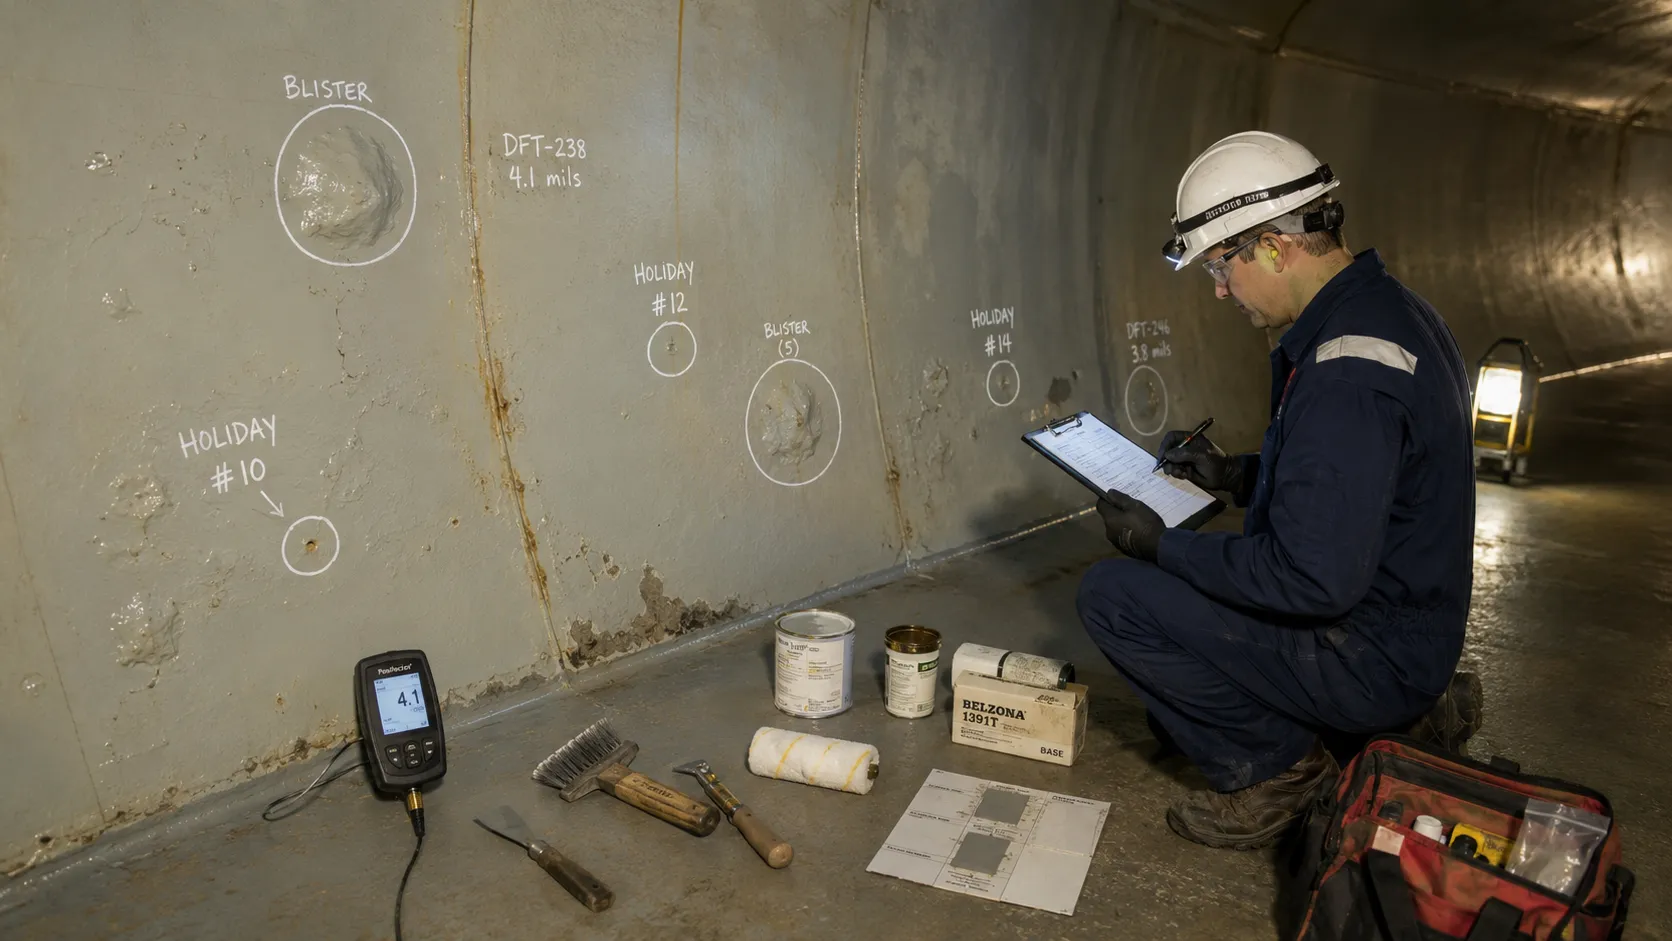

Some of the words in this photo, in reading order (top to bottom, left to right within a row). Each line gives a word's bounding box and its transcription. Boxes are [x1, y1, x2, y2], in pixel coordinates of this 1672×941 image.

[283, 75, 373, 103] BLISTER
[503, 133, 587, 160] DFT-238
[509, 165, 535, 189] 4.1
[546, 166, 582, 188] mils
[651, 291, 688, 317] #12
[970, 306, 1014, 329] HOLIDAY
[763, 320, 811, 339] BLISTER
[1126, 319, 1171, 340] DFT-246
[778, 338, 800, 358] (5)
[984, 333, 1012, 357] #14
[1131, 343, 1149, 363] 3.8
[1151, 340, 1172, 358] mils
[178, 414, 276, 460] HOLIDAY
[210, 457, 267, 495] #10
[397, 689, 420, 707] 4.1
[962, 699, 1026, 721] BELZONA
[962, 711, 999, 728] 1391T
[1040, 746, 1064, 758] BASE
